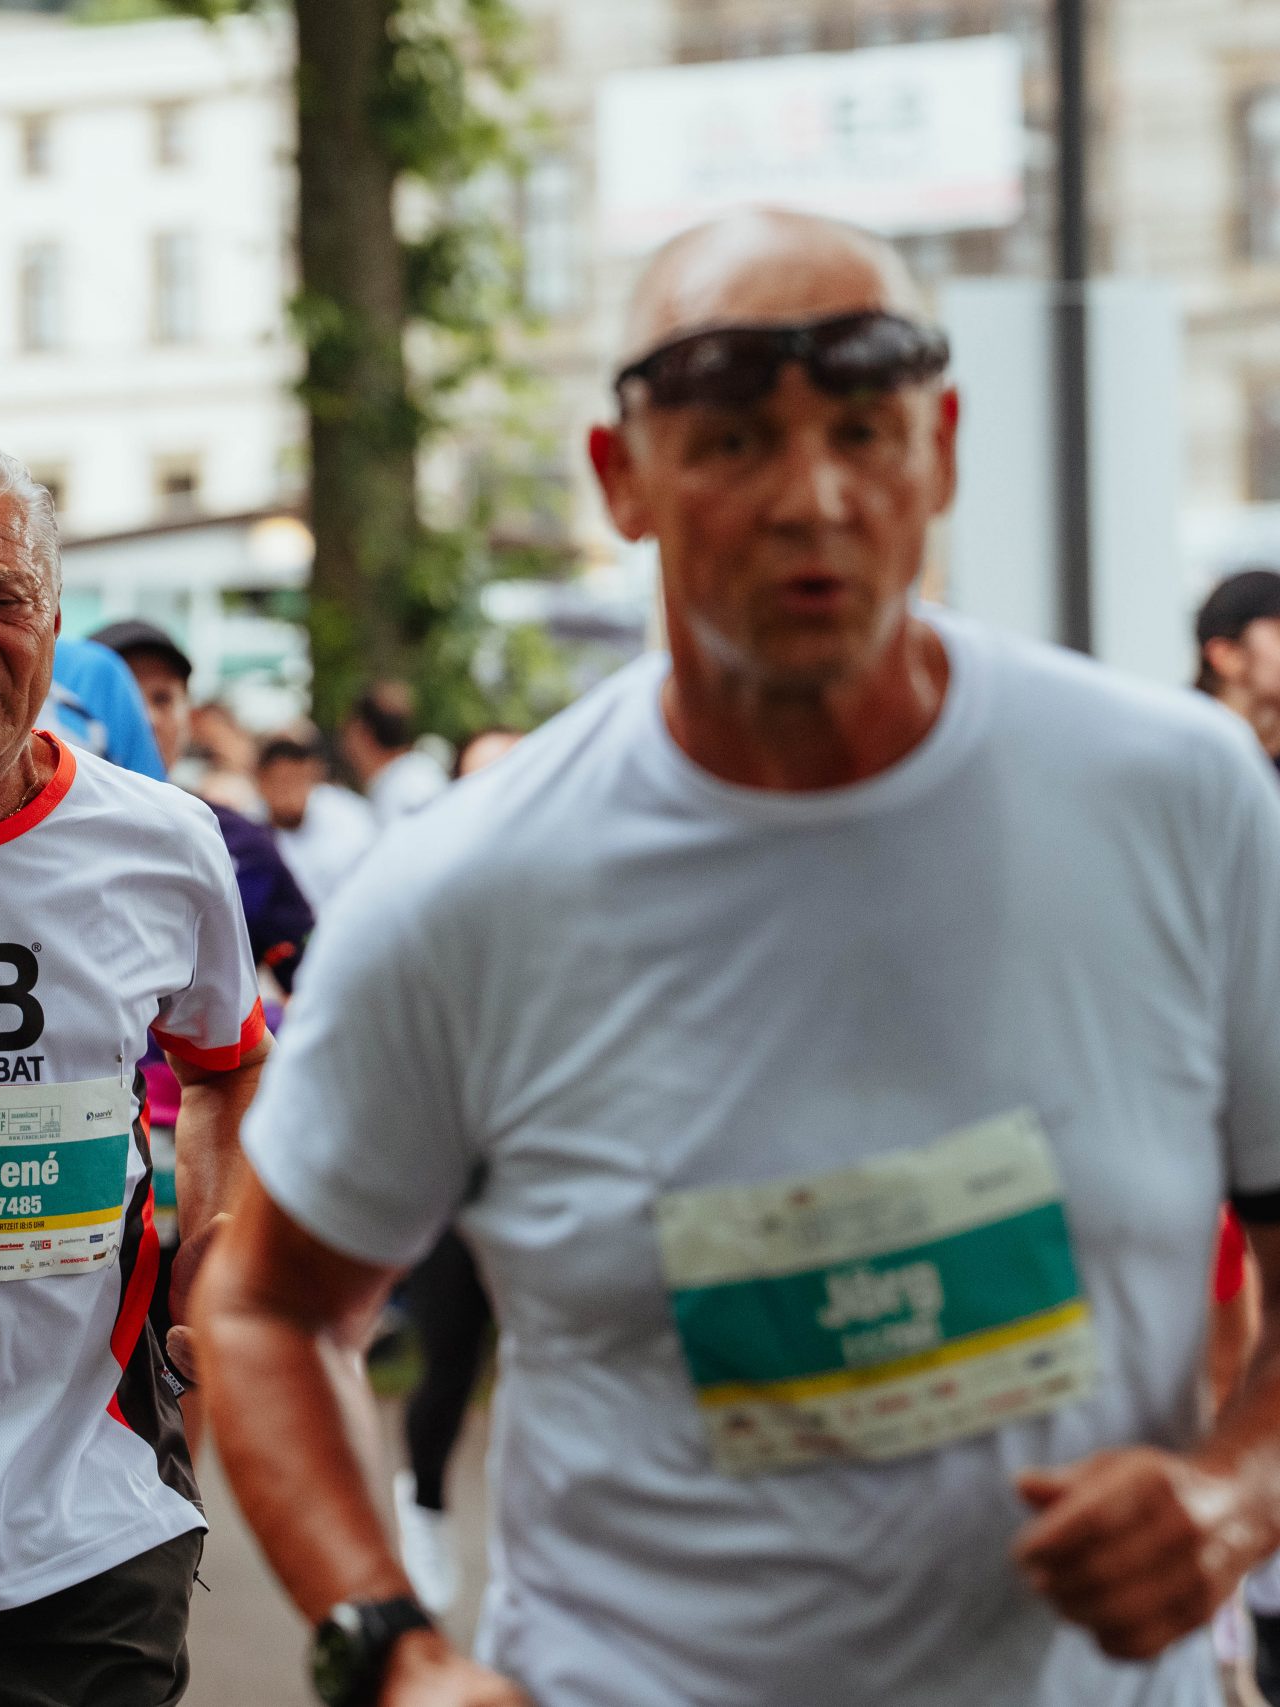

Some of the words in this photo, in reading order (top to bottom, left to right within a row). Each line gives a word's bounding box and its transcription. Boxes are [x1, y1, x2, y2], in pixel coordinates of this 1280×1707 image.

[20, 1221, 33, 1230] 18:15
[33, 1221, 45, 1229] UHR
[817, 1260, 943, 1337] Jörg
